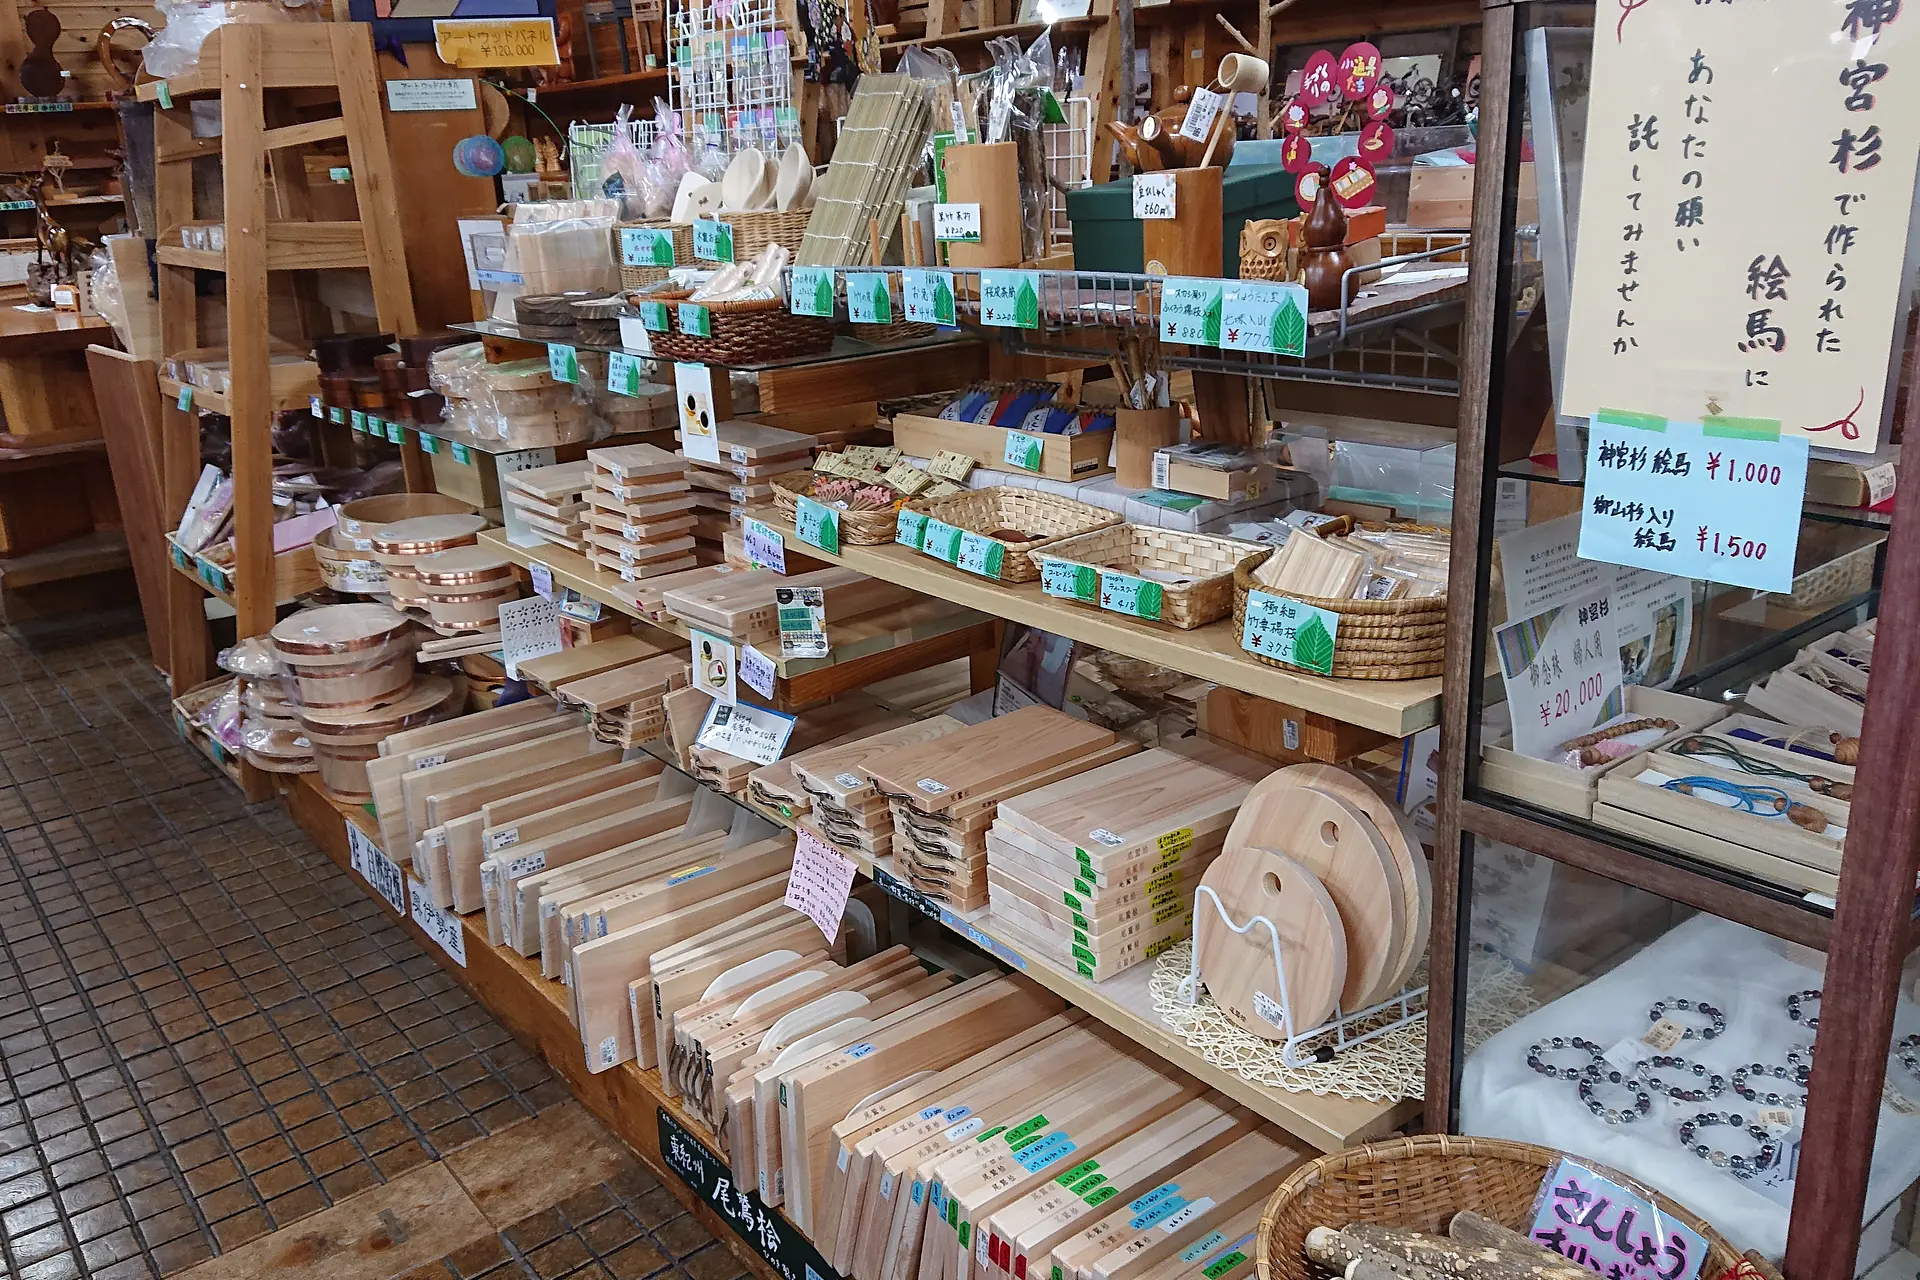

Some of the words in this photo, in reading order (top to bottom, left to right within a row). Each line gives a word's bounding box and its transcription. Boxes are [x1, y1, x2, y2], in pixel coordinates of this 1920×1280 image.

[440, 29, 550, 44] アートウッドパネル
[1675, 47, 1714, 252] あなたの願い
[1144, 202, 1167, 216] 560円
[1612, 113, 1660, 357] 託してみませんか
[1737, 253, 1792, 389] 絵馬に
[1599, 440, 1648, 471] 神宮杉
[1651, 447, 1691, 477] 絵馬
[1706, 451, 1781, 486] ¥1,000
[1633, 527, 1677, 552] 絵馬
[1696, 525, 1768, 560] ¥1,500
[1262, 599, 1297, 619] 極細
[1578, 597, 1610, 627] 神宮杉
[1251, 632, 1293, 658] ¥375
[1539, 671, 1603, 727] ¥20,000
[670, 1133, 706, 1185] 東紀州
[1553, 1178, 1687, 1280] さんしょう
